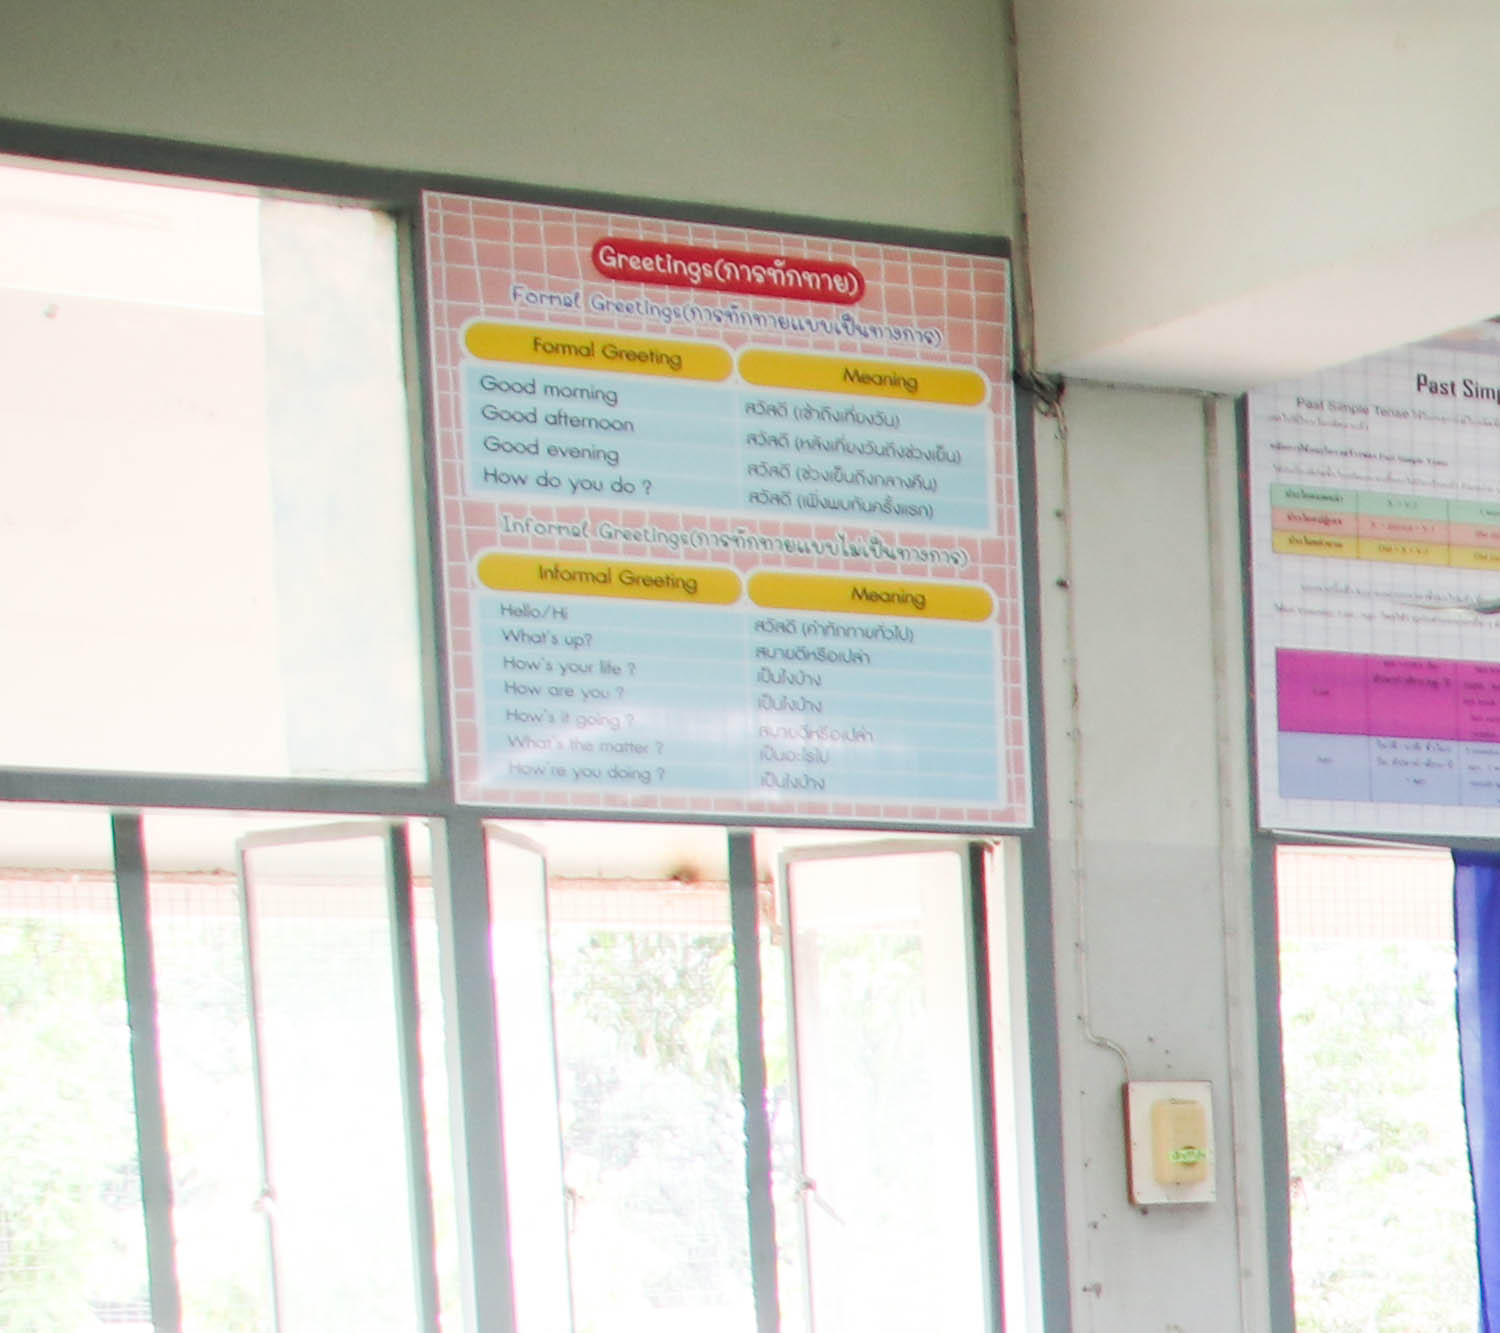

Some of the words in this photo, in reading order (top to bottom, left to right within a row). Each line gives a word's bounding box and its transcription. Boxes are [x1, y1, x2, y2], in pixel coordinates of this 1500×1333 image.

[511, 284, 580, 308] Formal
[533, 336, 595, 358] Formal
[601, 344, 683, 370] Greeting
[480, 375, 536, 395] Good
[544, 383, 618, 407] morning
[843, 367, 918, 394] Meaning
[1416, 372, 1456, 397] Past
[481, 404, 538, 424] Good
[545, 408, 634, 433] afternoon
[746, 399, 788, 417] สวัสดี
[483, 435, 539, 456] Good
[547, 442, 619, 466] evening
[746, 431, 789, 448] สวัสดี
[483, 467, 528, 486] How
[535, 470, 561, 488] do
[569, 478, 604, 495] you
[610, 476, 636, 495] do
[747, 462, 791, 480] สวัสดี
[748, 488, 792, 507] สวัสดี
[499, 514, 589, 539] Informal
[538, 565, 612, 586] Informal
[619, 570, 698, 594] Greeting
[851, 586, 927, 610] Meaning
[754, 618, 797, 635] สวัสดี
[502, 628, 559, 646] What's
[565, 632, 593, 650] up?
[503, 656, 553, 672] How's
[559, 664, 593, 676] your
[600, 659, 622, 676] life
[504, 681, 541, 697] How
[547, 685, 574, 698] are
[581, 687, 609, 702] you
[506, 708, 555, 724] How's
[573, 767, 600, 782] you
[607, 765, 651, 784] doing
